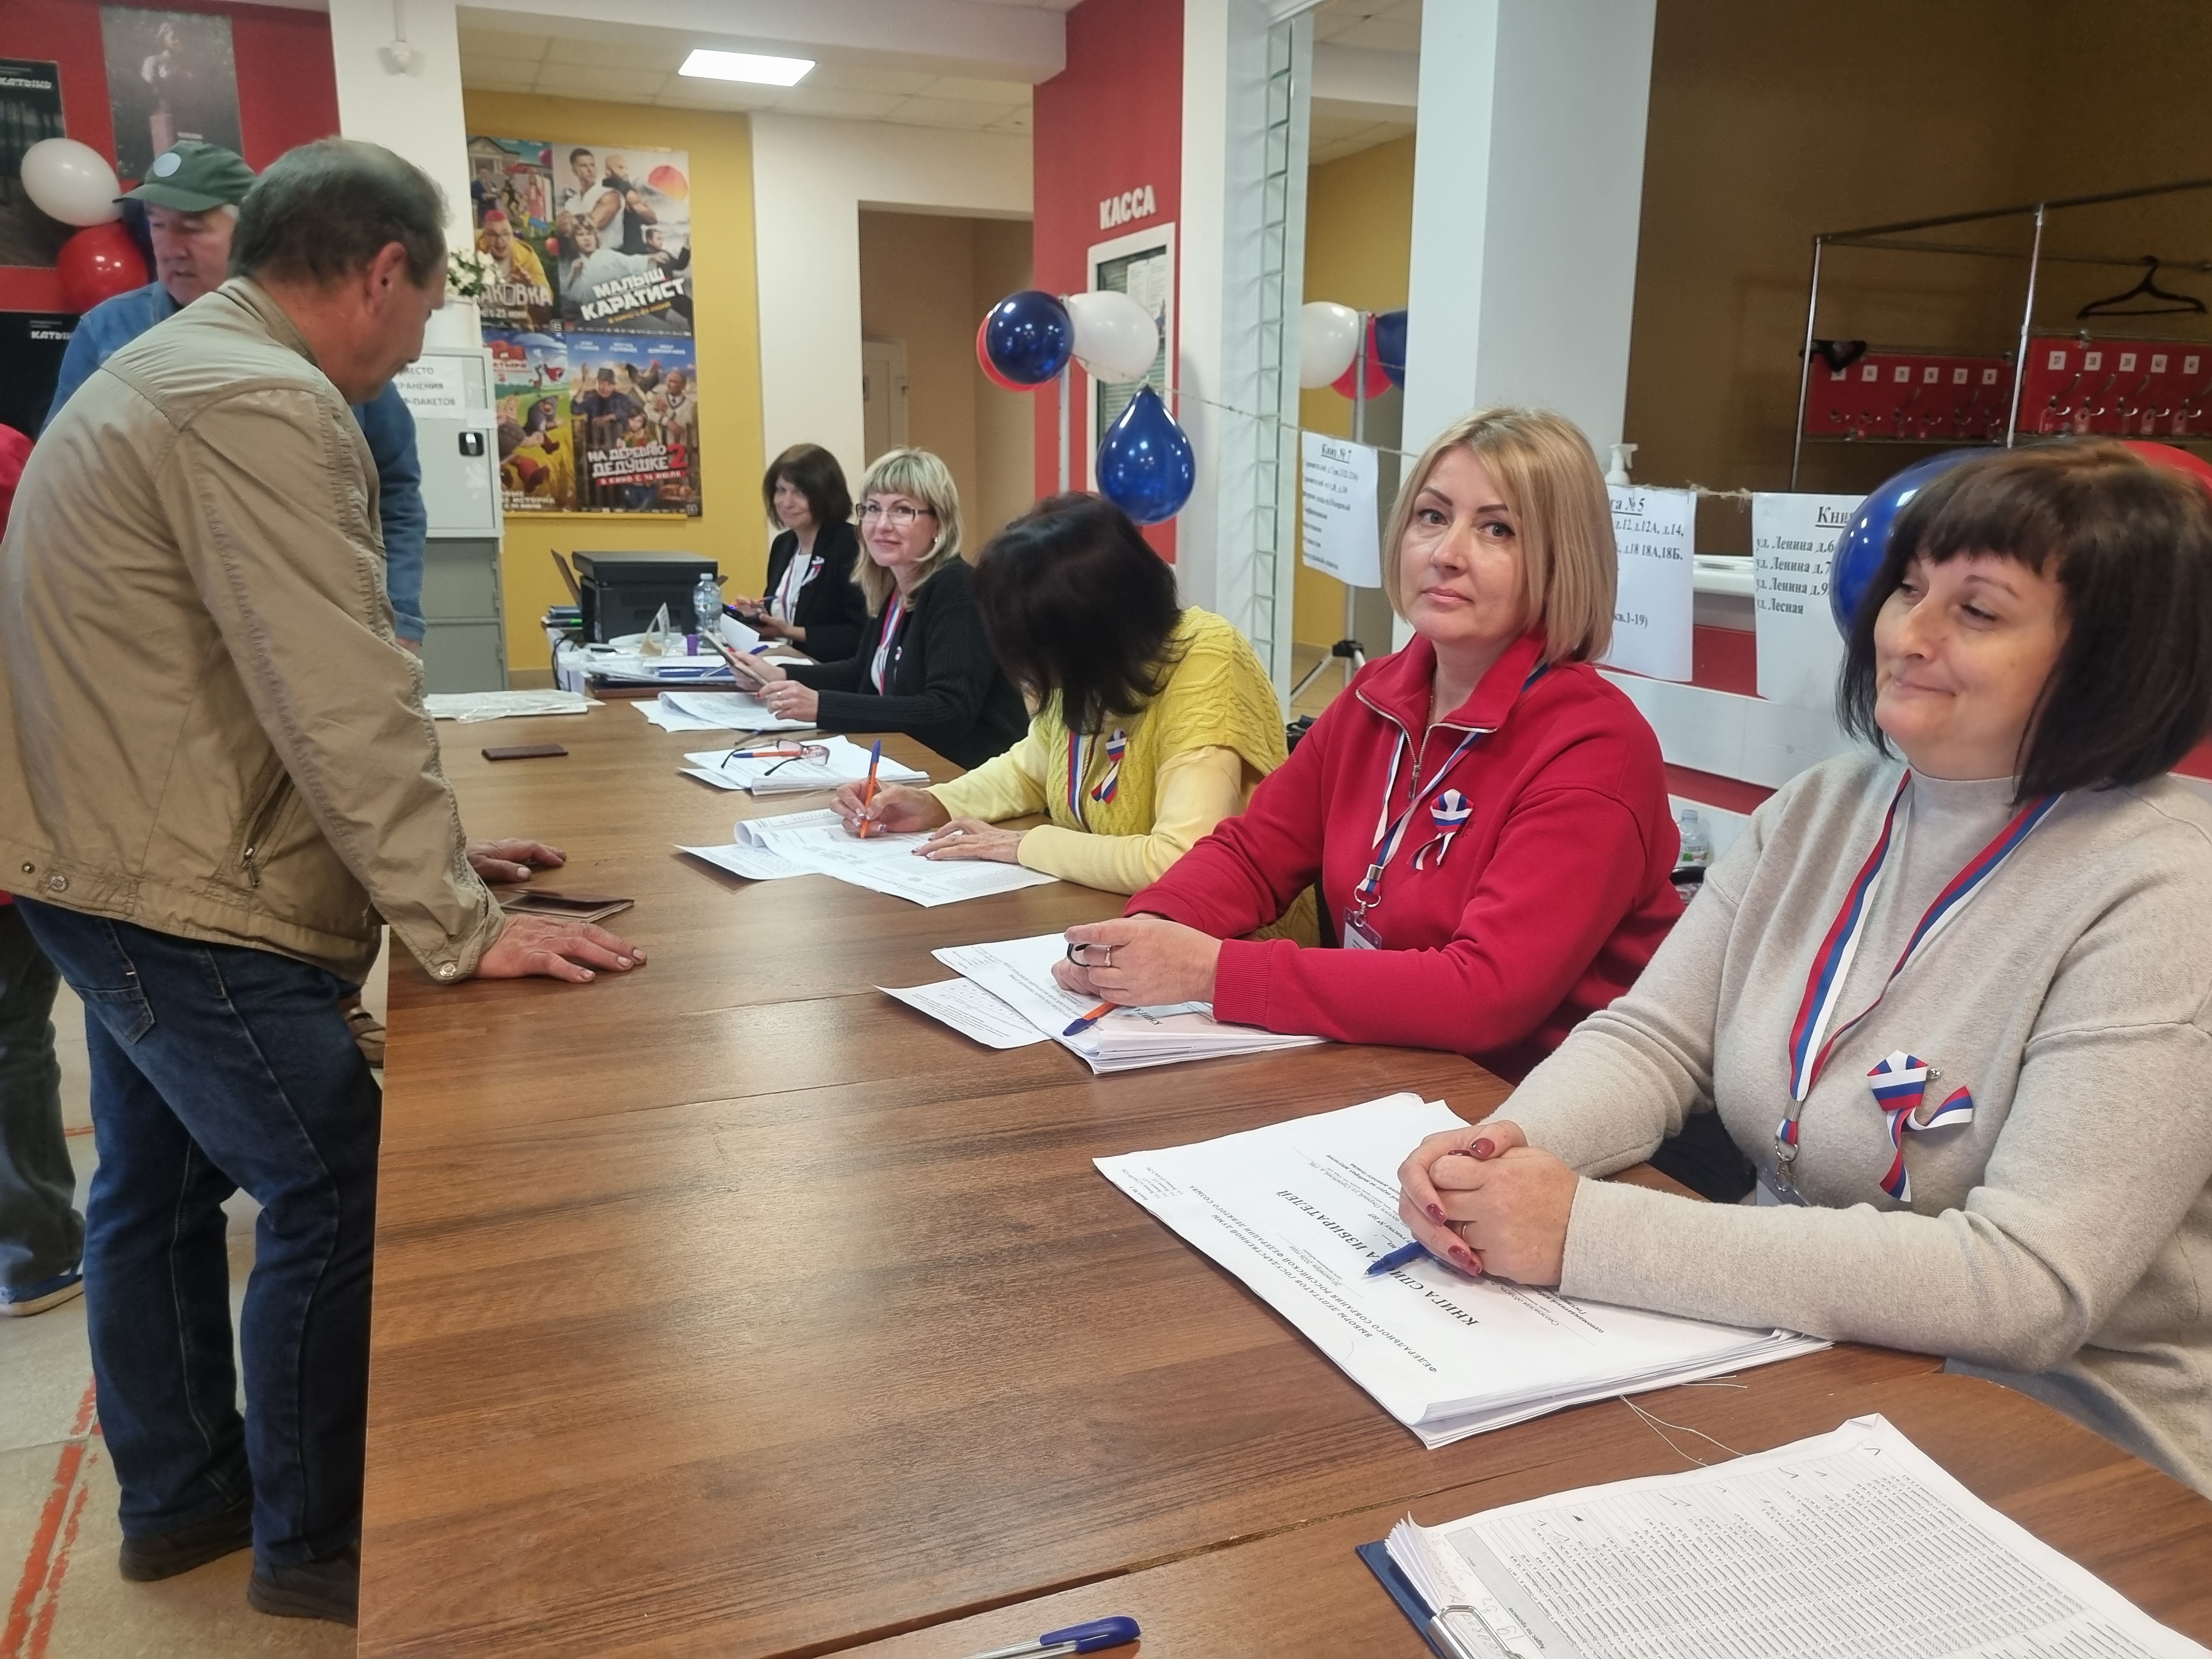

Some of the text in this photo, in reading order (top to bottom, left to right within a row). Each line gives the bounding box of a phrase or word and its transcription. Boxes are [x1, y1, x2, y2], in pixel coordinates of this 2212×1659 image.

[1099, 184, 1156, 231] КАССА
[591, 267, 666, 299] МАЛЫШ
[580, 278, 685, 321] КАРАТИСТ
[31, 331, 72, 341] КАТЫ
[587, 450, 608, 463] НА
[592, 443, 688, 479] ДЕДУШКЕ 2
[1625, 497, 1636, 511] №
[1637, 497, 1646, 513] 5
[1817, 506, 1854, 524] Кни
[1771, 535, 1814, 552] Ленина
[1770, 556, 1811, 573] Ленина
[1768, 577, 1808, 594] Ленина
[1767, 597, 1804, 615] Лесная
[1326, 1155, 1351, 1170] депутатов
[1276, 1190, 1368, 1250] ИЗБИРАТЕЛЕЙ
[1384, 1225, 1408, 1240] участку
[1189, 1185, 1437, 1372] ФЕДЕРАЛЬНОГО СОБРАНИЯ РОССИЙСКОЙ ФЕДЕРАЦИИ ДЕВЯТОГО СОЗЫВА
[1211, 1214, 1373, 1338] ВЫБОРЫ ДЕПУТАТОВ ГОСУДАРСТВЕННОЙ ДУМЫ
[1359, 1250, 1429, 1291] СПИА
[1424, 1290, 1480, 1326] КНИГА
[1548, 1298, 1604, 1333] одномандатный
[1508, 1608, 1528, 1629] прописке
[1531, 1634, 1546, 1649] Адрес
